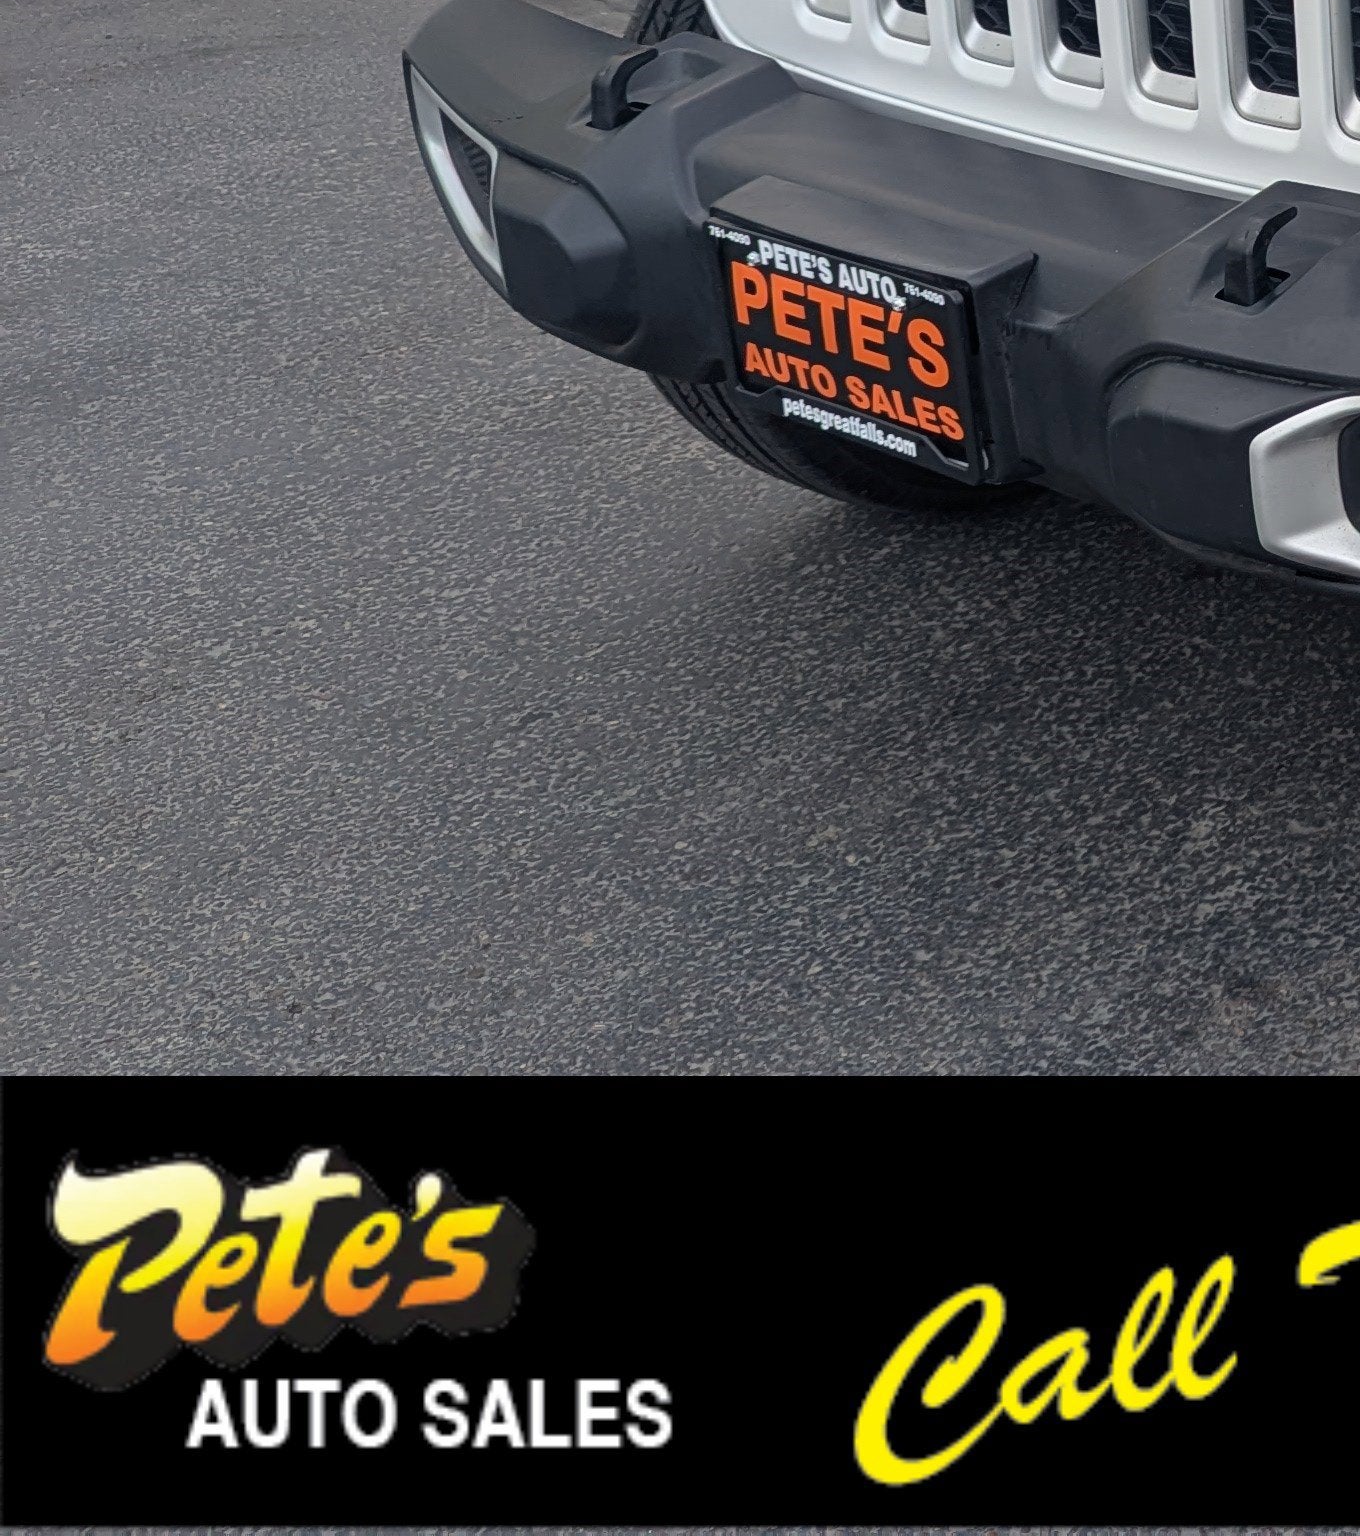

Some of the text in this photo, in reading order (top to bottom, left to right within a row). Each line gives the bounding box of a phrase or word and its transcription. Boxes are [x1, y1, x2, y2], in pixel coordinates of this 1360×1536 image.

[757, 239, 834, 284] PETE'S
[837, 263, 898, 304] AUTO
[731, 261, 950, 388] PETE'S
[744, 341, 965, 441] AUTO SALES
[782, 397, 917, 458] petesgreatfalls.com
